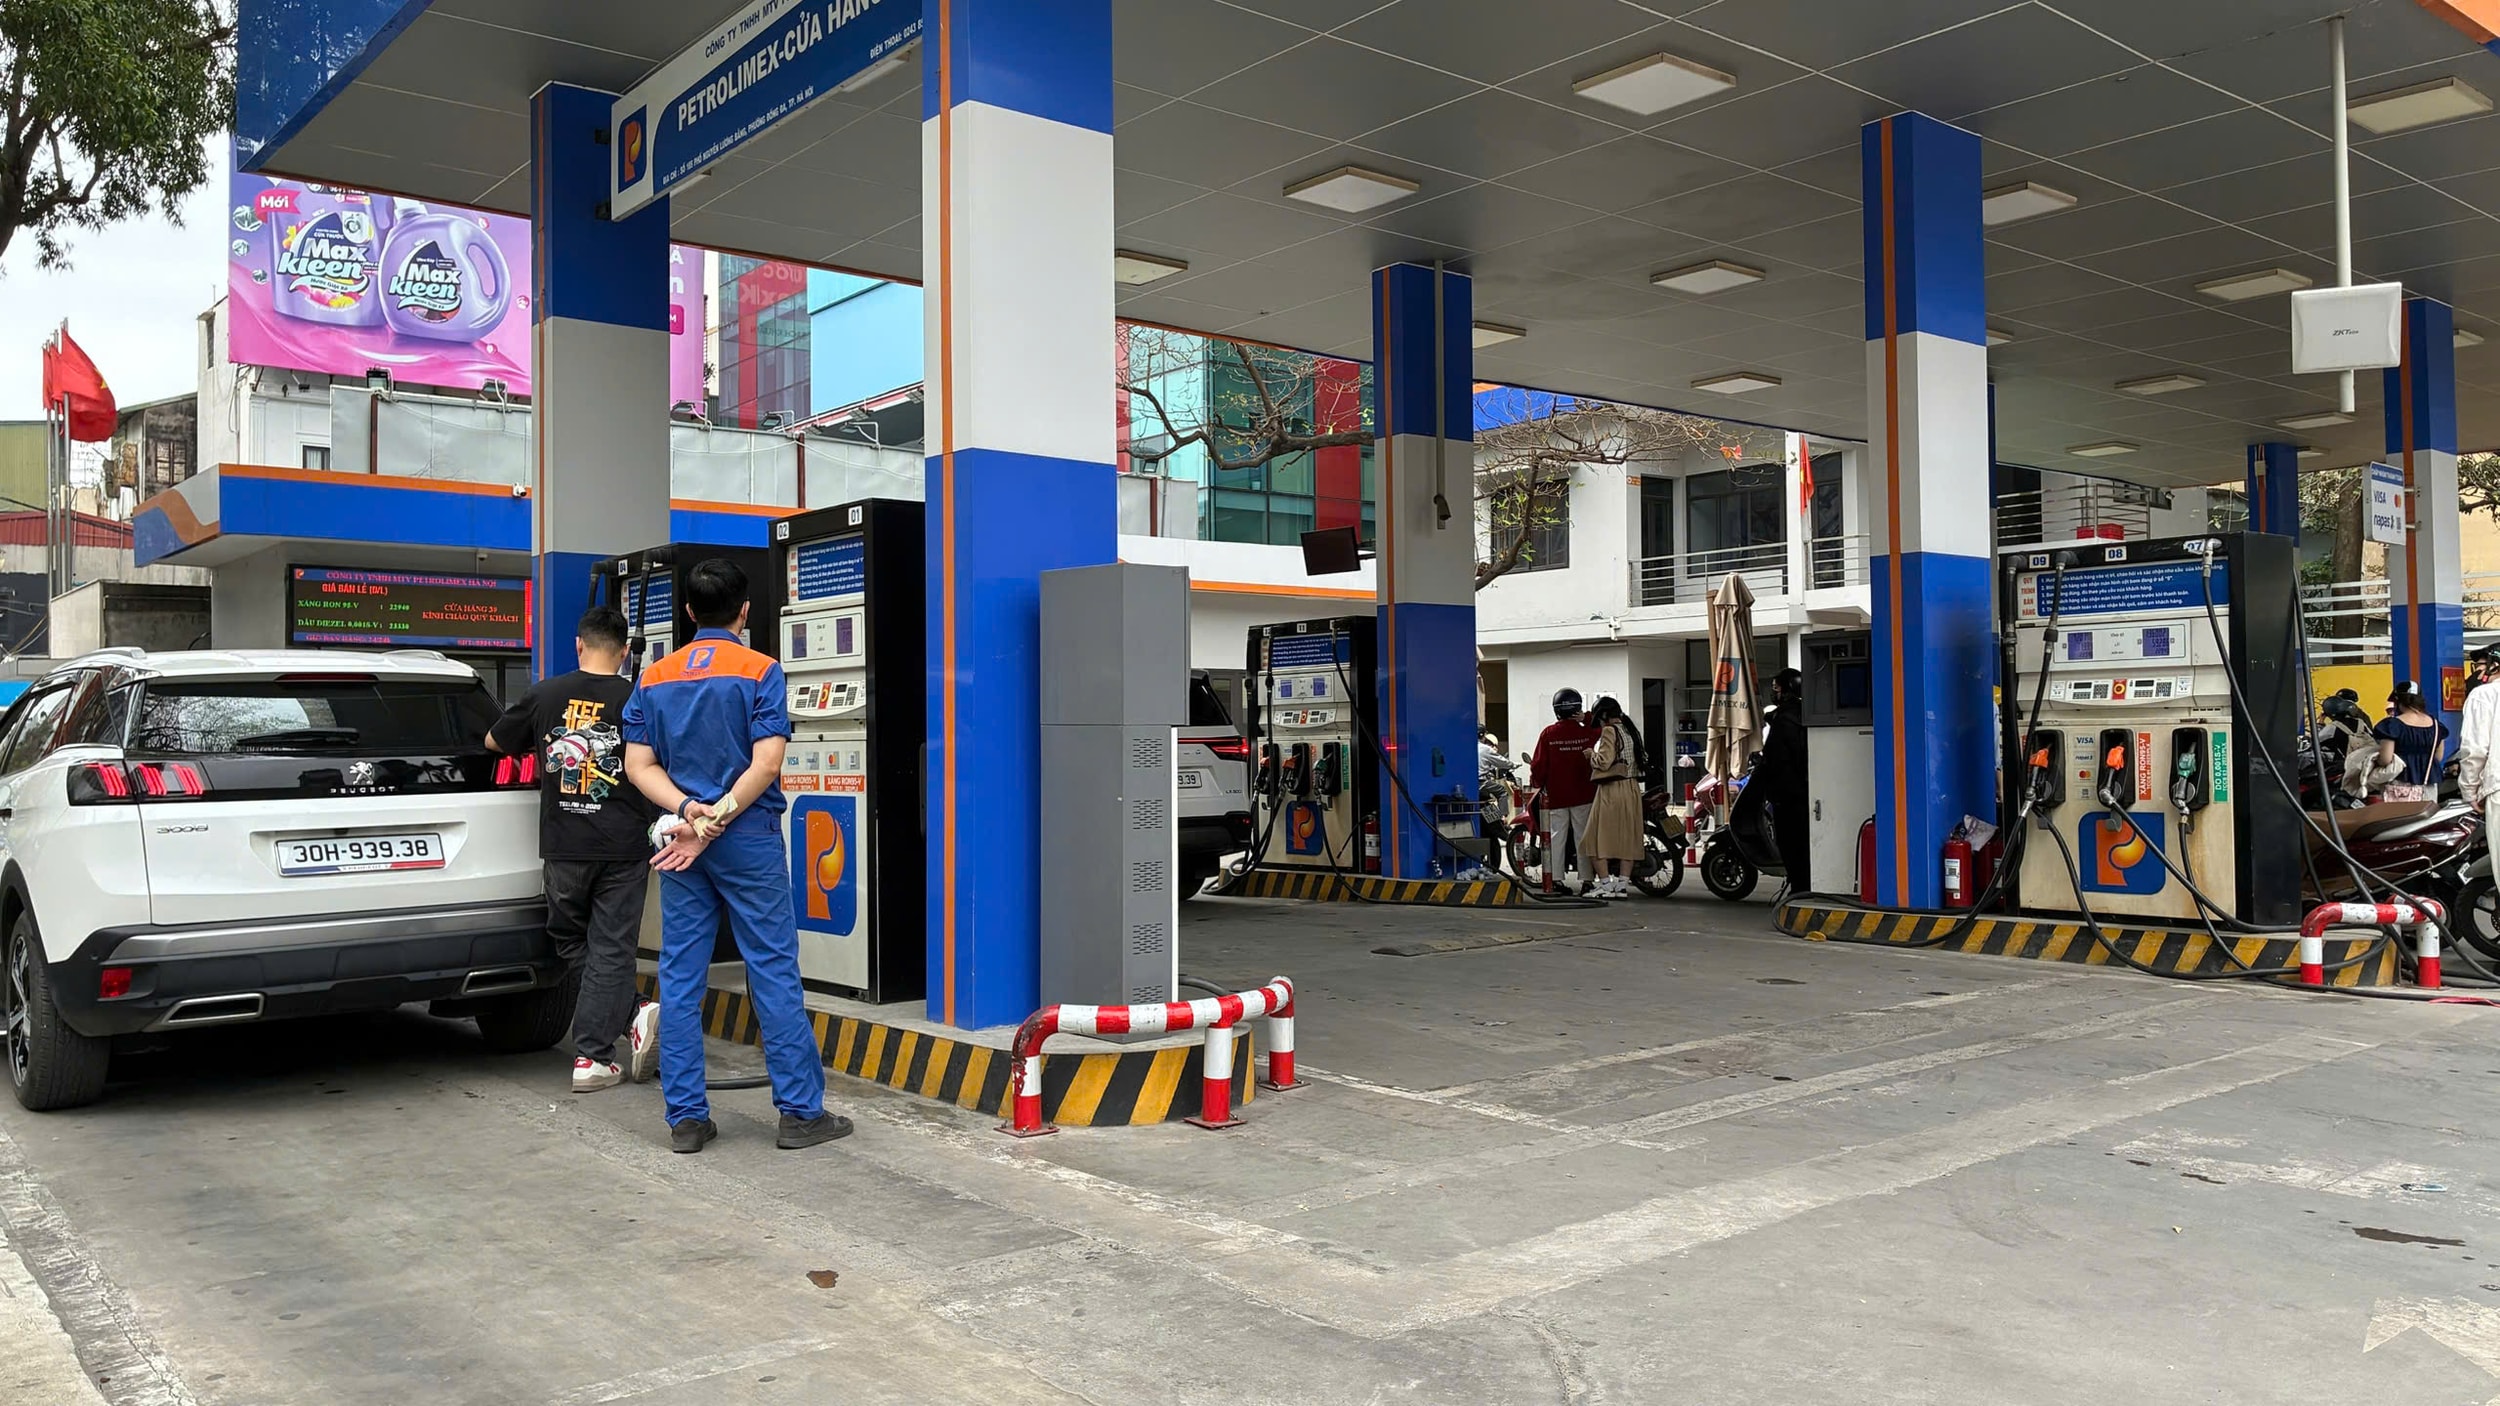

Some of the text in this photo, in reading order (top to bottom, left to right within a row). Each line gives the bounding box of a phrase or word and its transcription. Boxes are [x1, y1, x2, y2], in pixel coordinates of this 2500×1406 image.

[705, 0, 779, 58] CÔNG TY TNHH MTV
[870, 21, 916, 59] ĐIỆN THOẠI: 0243
[678, 12, 822, 131] PETROLIMEX-CỬA
[703, 143, 719, 161] NGUYỄN
[719, 134, 734, 151] LƯƠNG
[748, 114, 766, 134] PHƯỜNG
[766, 108, 779, 122] ĐỐNG
[796, 90, 804, 104] HÀ
[804, 85, 814, 99] NỘI
[260, 195, 288, 208] Mới
[304, 238, 370, 261] Max
[277, 252, 363, 279] kleen
[408, 263, 462, 283] Max
[389, 276, 456, 299] kleen
[2374, 490, 2386, 504] VISA
[851, 508, 860, 523] 01
[2374, 514, 2390, 530] napas
[779, 524, 787, 538] 02
[2108, 548, 2124, 559] 08
[2032, 557, 2046, 566] 09
[326, 571, 352, 580] CÔNG
[413, 576, 468, 586] PETROLIMEX
[322, 583, 336, 592] GIÁ
[338, 583, 355, 593] BÁN
[357, 582, 367, 594] LẺ
[444, 602, 463, 612] CỬA
[464, 604, 487, 612] HÀNG
[422, 610, 444, 619] KÍNH
[444, 612, 468, 620] CHÀO
[489, 614, 518, 622] KHÁCH
[787, 756, 799, 766] VISA
[330, 785, 397, 794] PEUGEOT
[2215, 779, 2221, 791] DO
[156, 823, 208, 834] 3008
[293, 840, 428, 863] 30H-939.38
